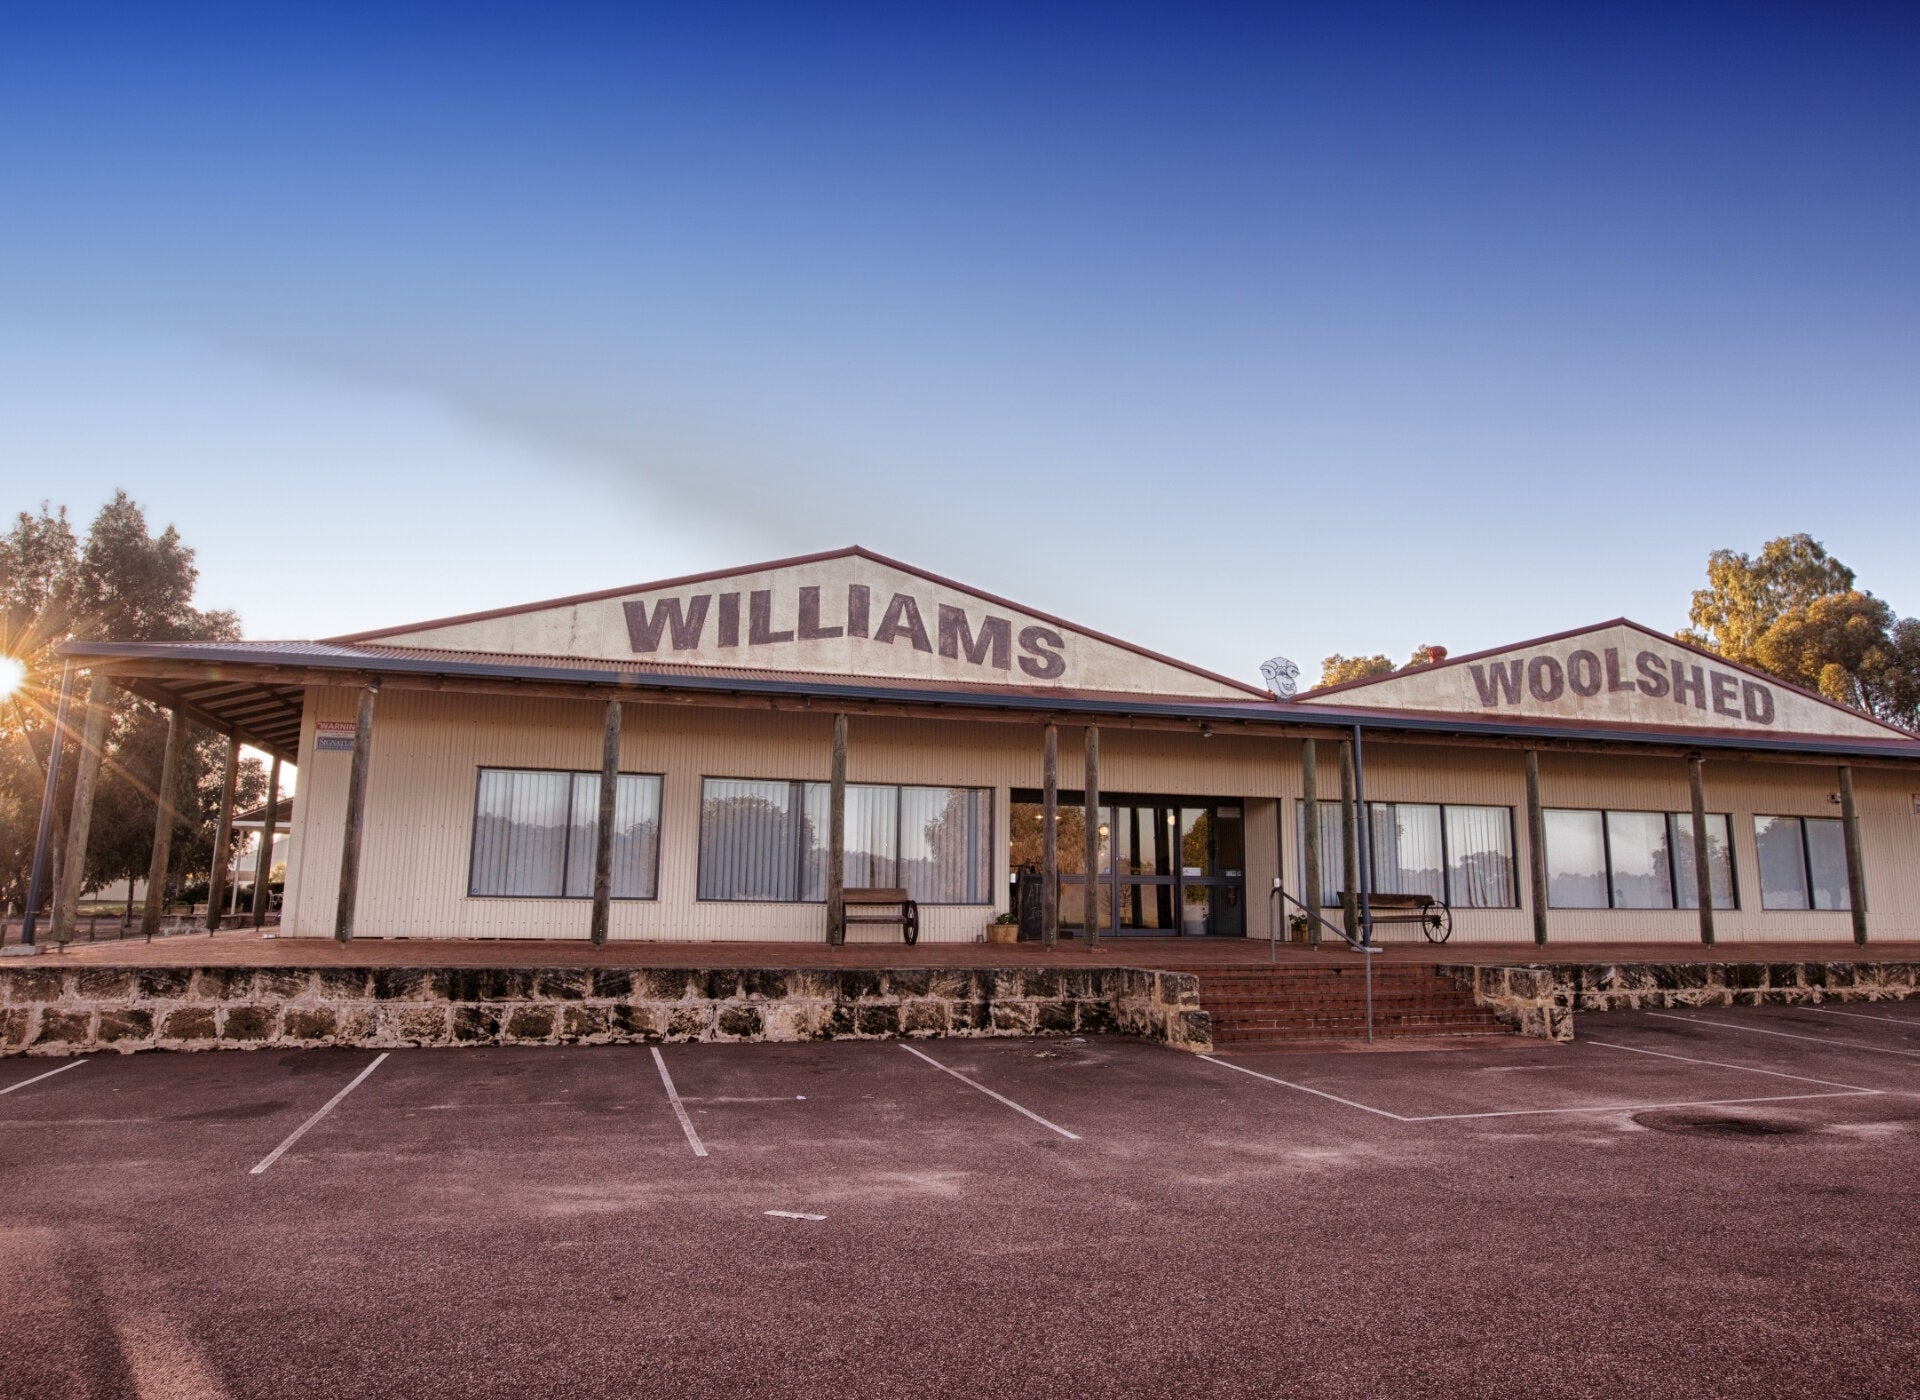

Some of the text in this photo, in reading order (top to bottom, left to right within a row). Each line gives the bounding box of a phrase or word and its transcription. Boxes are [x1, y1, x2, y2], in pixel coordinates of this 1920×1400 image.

[622, 584, 1067, 680] WILLIAMS
[1470, 647, 1775, 725] WOOLSHED
[319, 722, 356, 731] WARNIN
